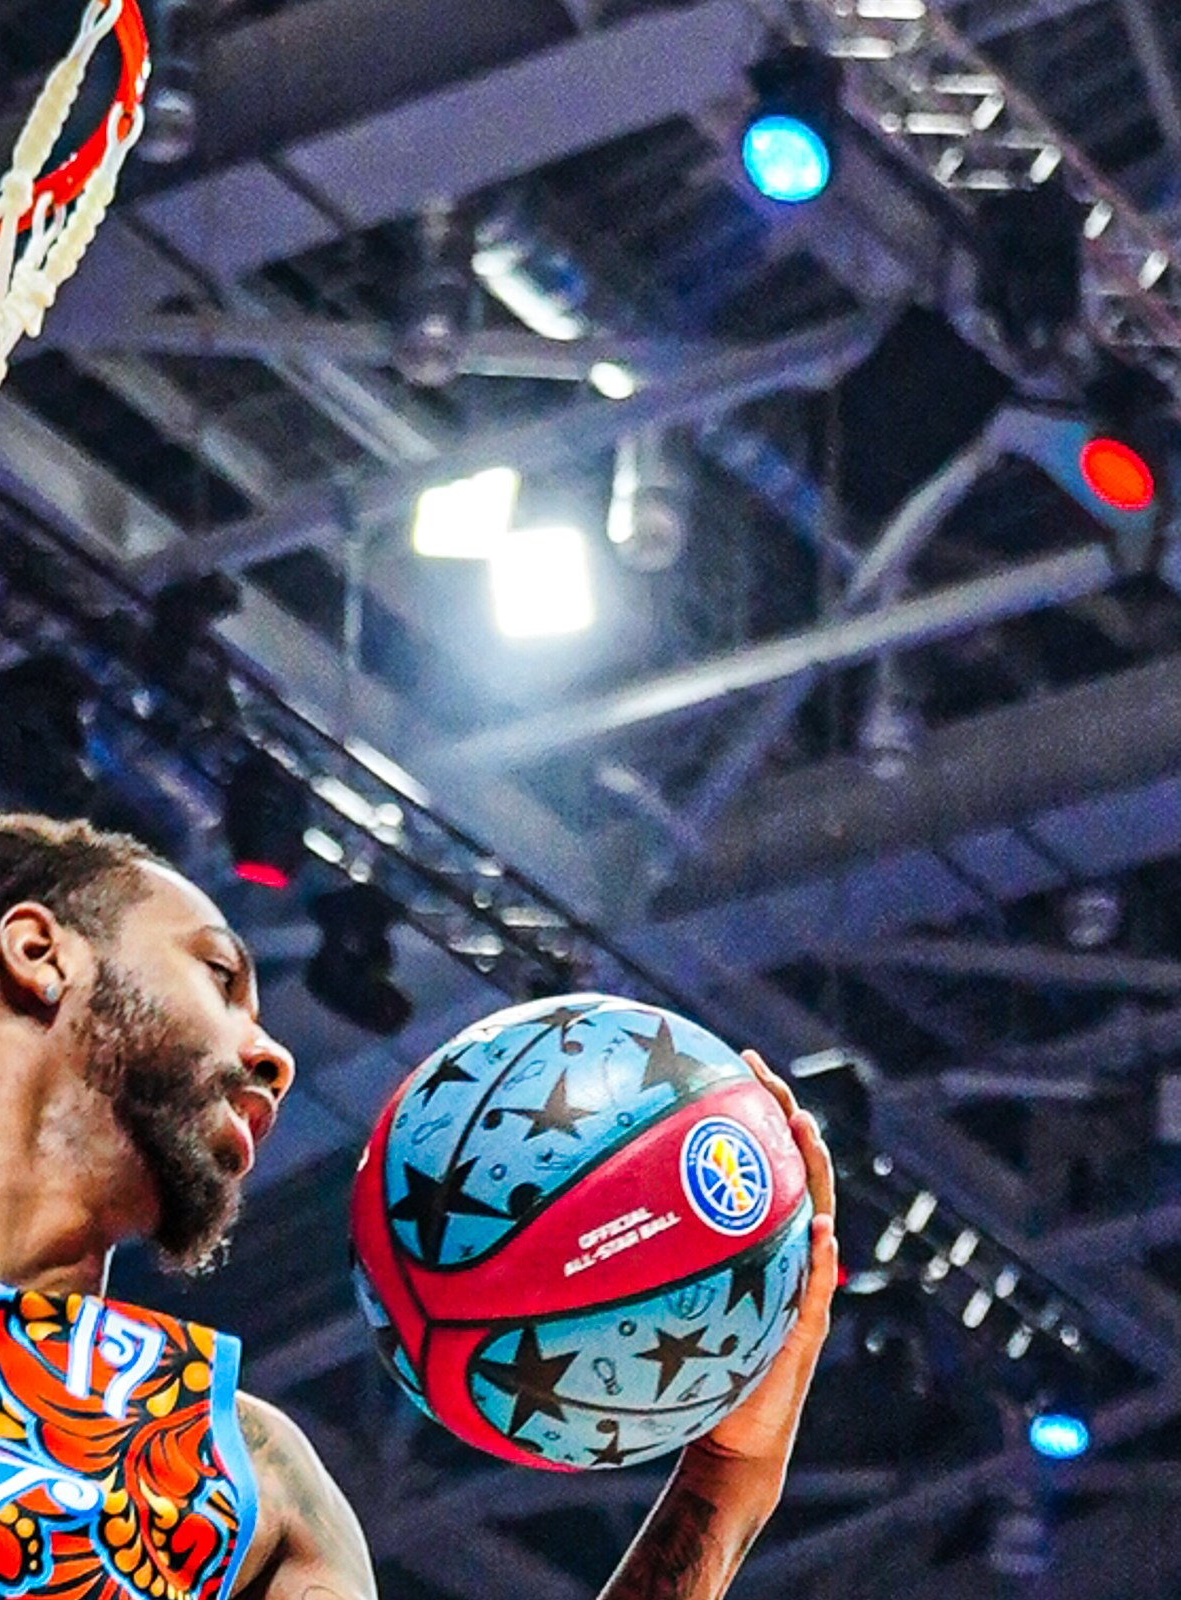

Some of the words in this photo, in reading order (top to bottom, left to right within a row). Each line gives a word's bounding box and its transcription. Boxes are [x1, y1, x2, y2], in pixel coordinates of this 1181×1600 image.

[578, 1206, 655, 1251] OFFICIAL
[638, 1210, 682, 1240] BALL
[65, 1295, 167, 1420] 17
